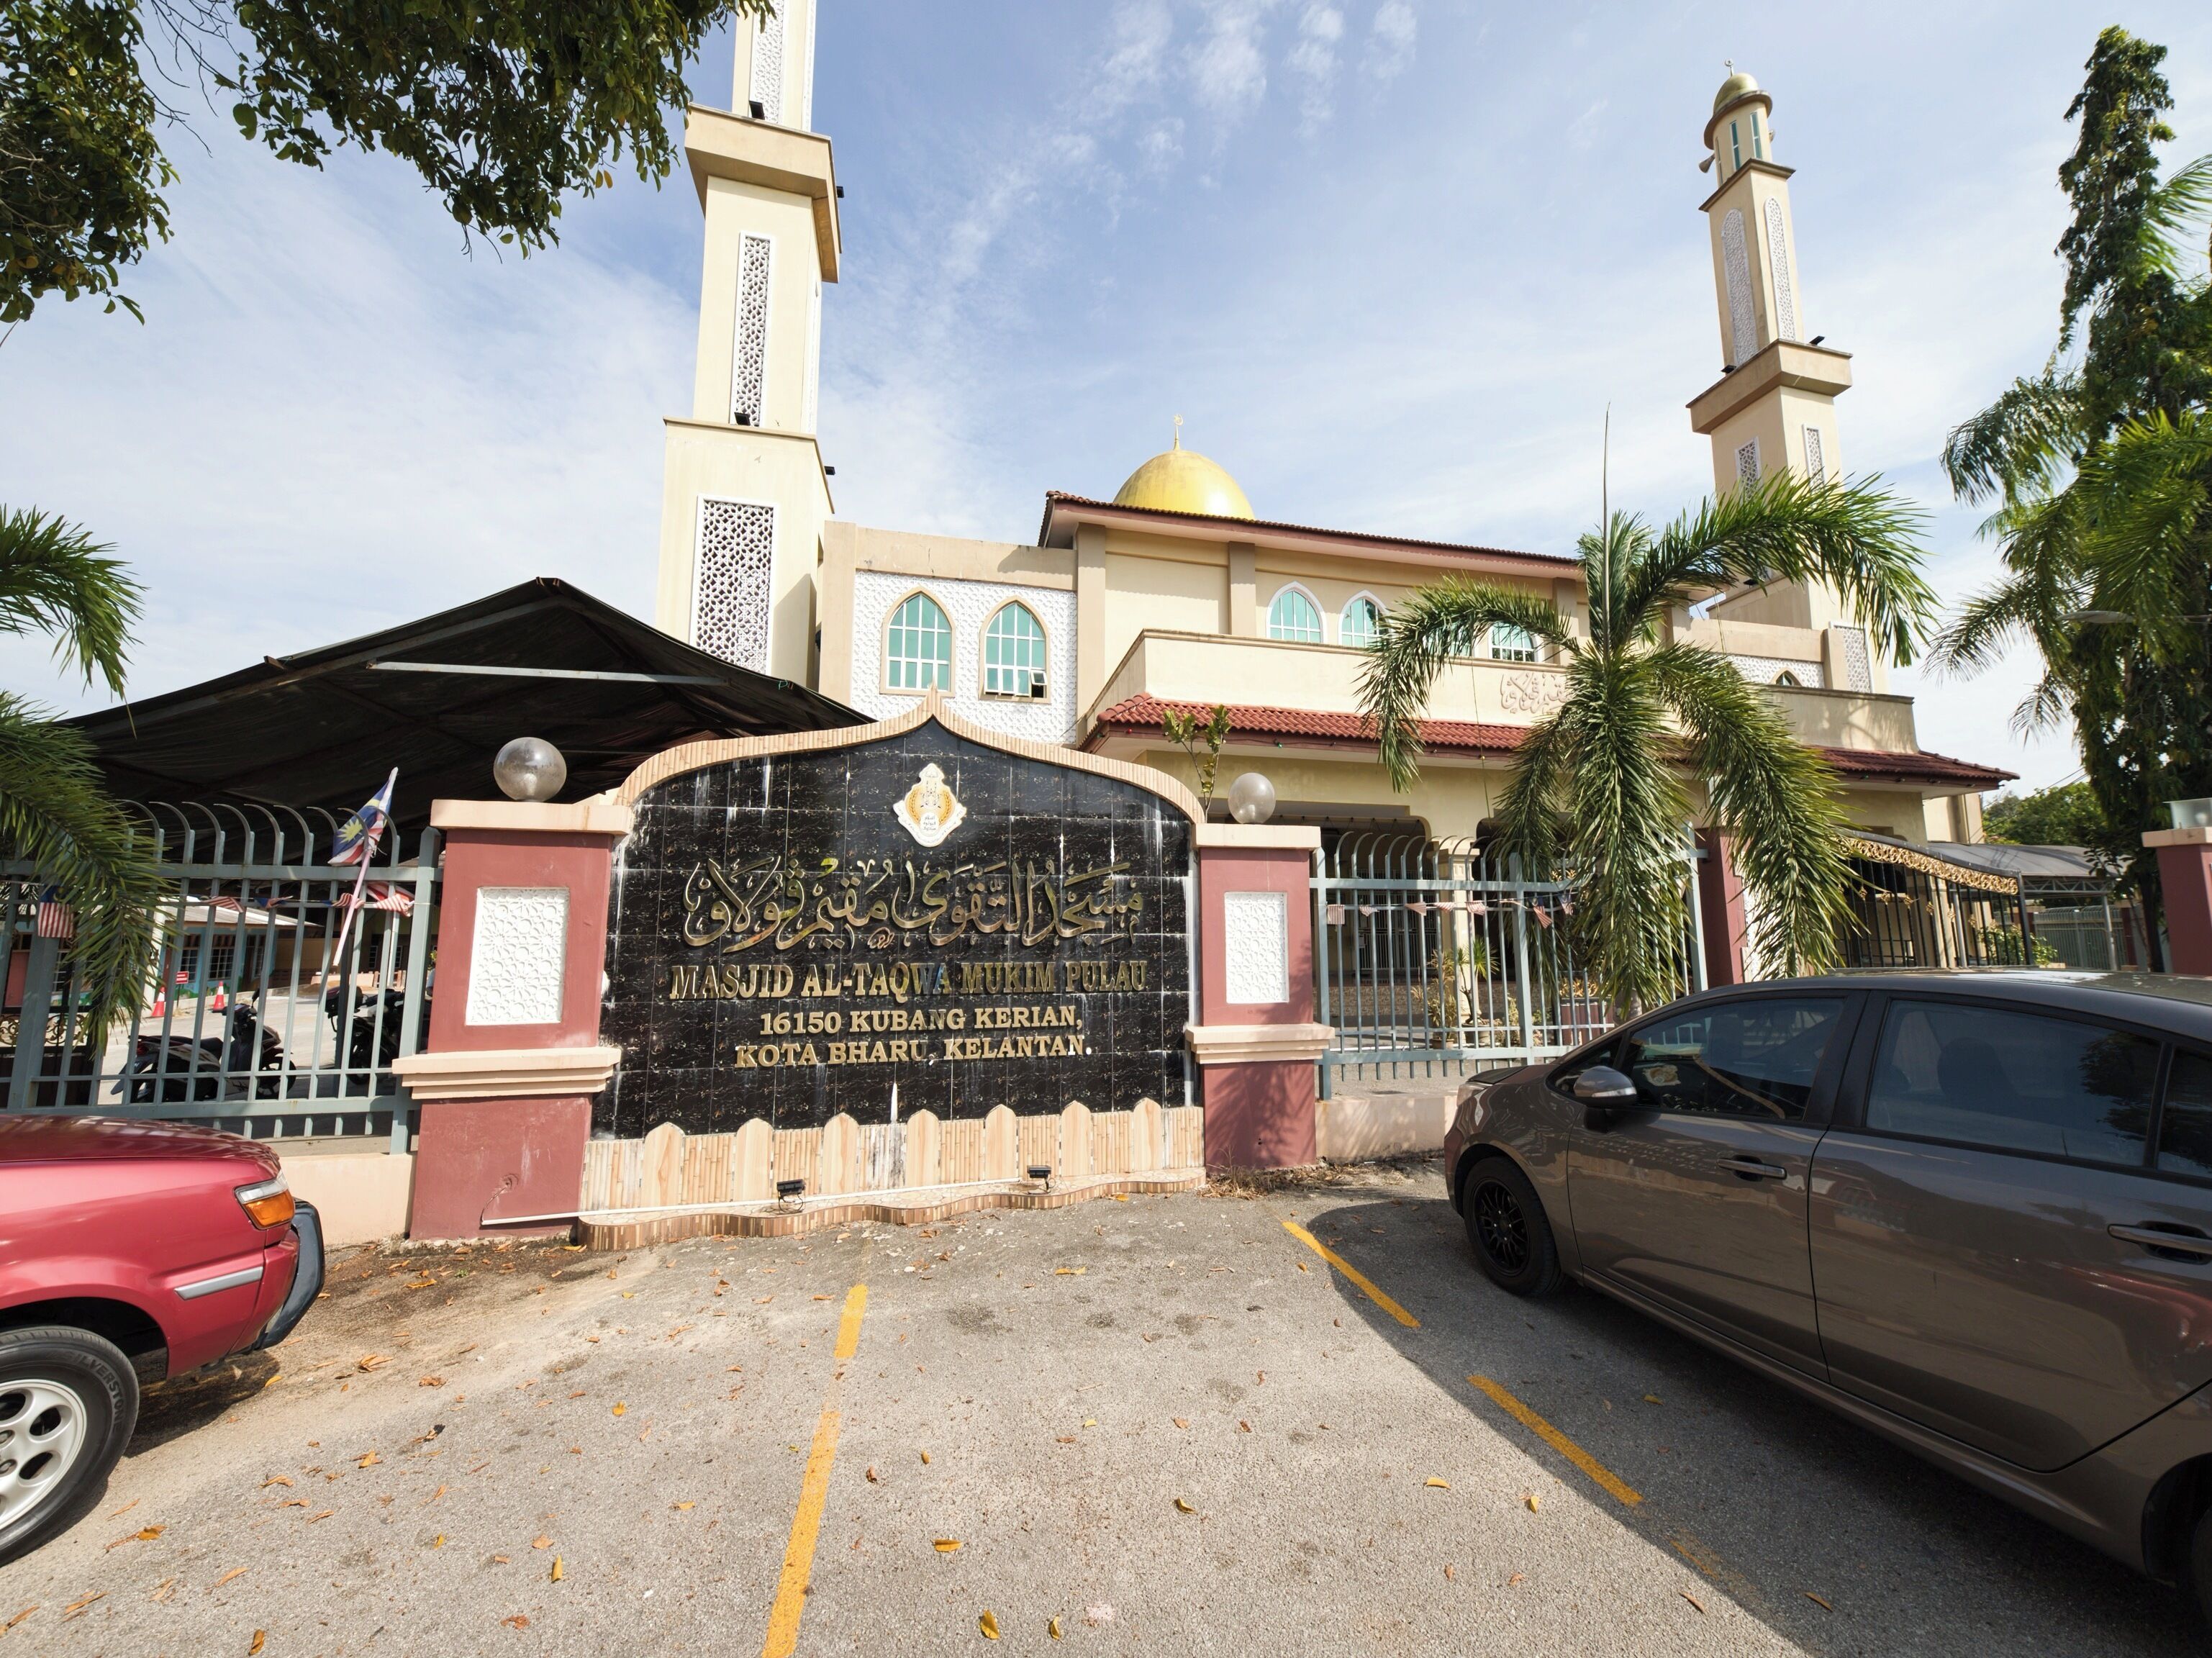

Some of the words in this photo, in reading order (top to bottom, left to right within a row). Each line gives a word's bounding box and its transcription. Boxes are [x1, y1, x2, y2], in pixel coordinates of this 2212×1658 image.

[669, 964, 794, 1000] MASJID
[800, 961, 953, 1003] AL-TAQWA
[960, 961, 1056, 995] MUKIM
[1065, 960, 1148, 992] PULAU
[760, 1011, 842, 1035] 16150
[849, 1008, 966, 1033] KUBANG
[974, 1005, 1083, 1030] KERIAN,
[734, 1043, 819, 1068] KOTA
[828, 1040, 935, 1066] BHARU,
[943, 1035, 1092, 1060] KELANTAN.
